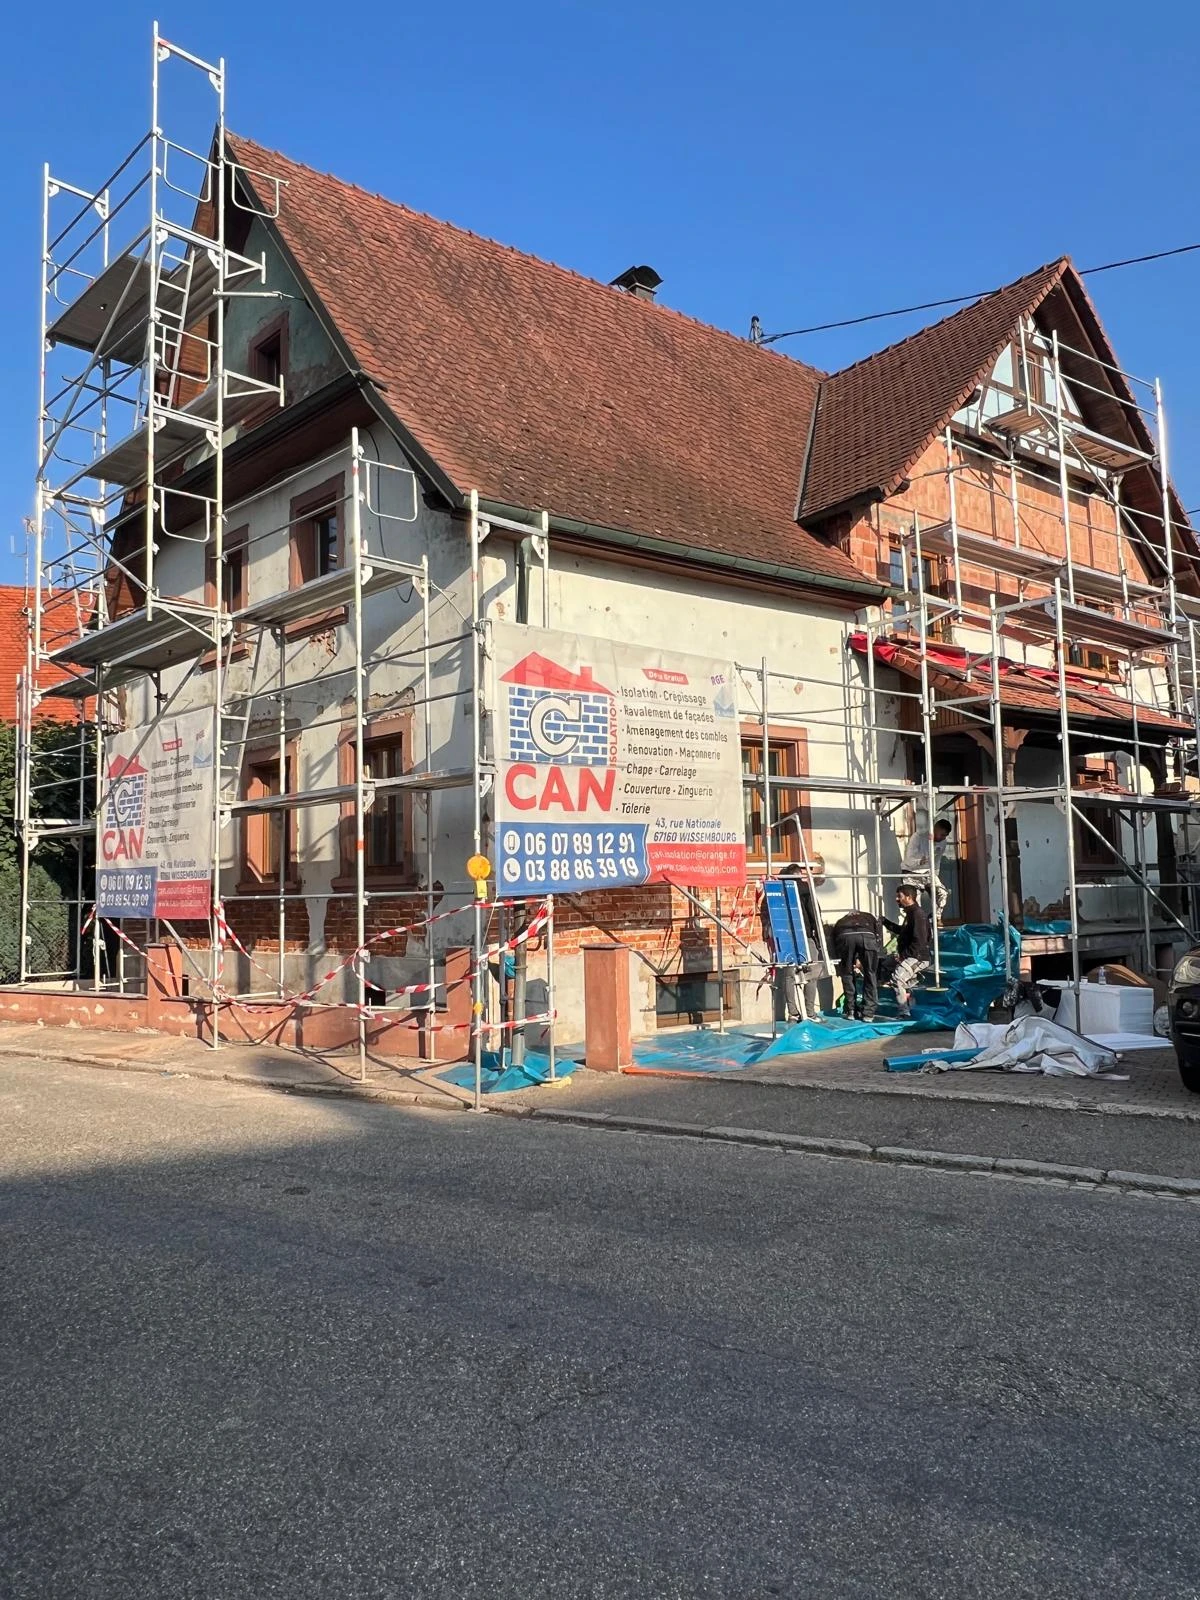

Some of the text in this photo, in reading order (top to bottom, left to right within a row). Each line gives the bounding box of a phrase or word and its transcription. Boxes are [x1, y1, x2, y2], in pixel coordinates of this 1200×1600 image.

[711, 674, 725, 686] RGE
[621, 686, 707, 706] Isolation Crépissage
[624, 705, 672, 719] Ravalement
[673, 711, 683, 720] de
[685, 710, 714, 724] façades
[608, 697, 618, 768] ISOLATION
[626, 724, 728, 743] Aménagement des combles
[628, 743, 721, 760] Rénovation Maçonnerie
[626, 763, 697, 779] Chape Carrelage
[505, 763, 616, 812] CAN
[624, 783, 713, 798] Couverture Zinguerie
[621, 802, 651, 815] Tôlerie
[655, 817, 721, 829] 43, rue Nationale
[102, 827, 145, 860] CAN
[524, 832, 635, 856] 06 07 89 12 91
[653, 832, 737, 842] 67160 WISSEMBOURG
[525, 857, 639, 882] 03 88 86 39 19
[108, 875, 116, 890] 06
[135, 874, 143, 889] 12
